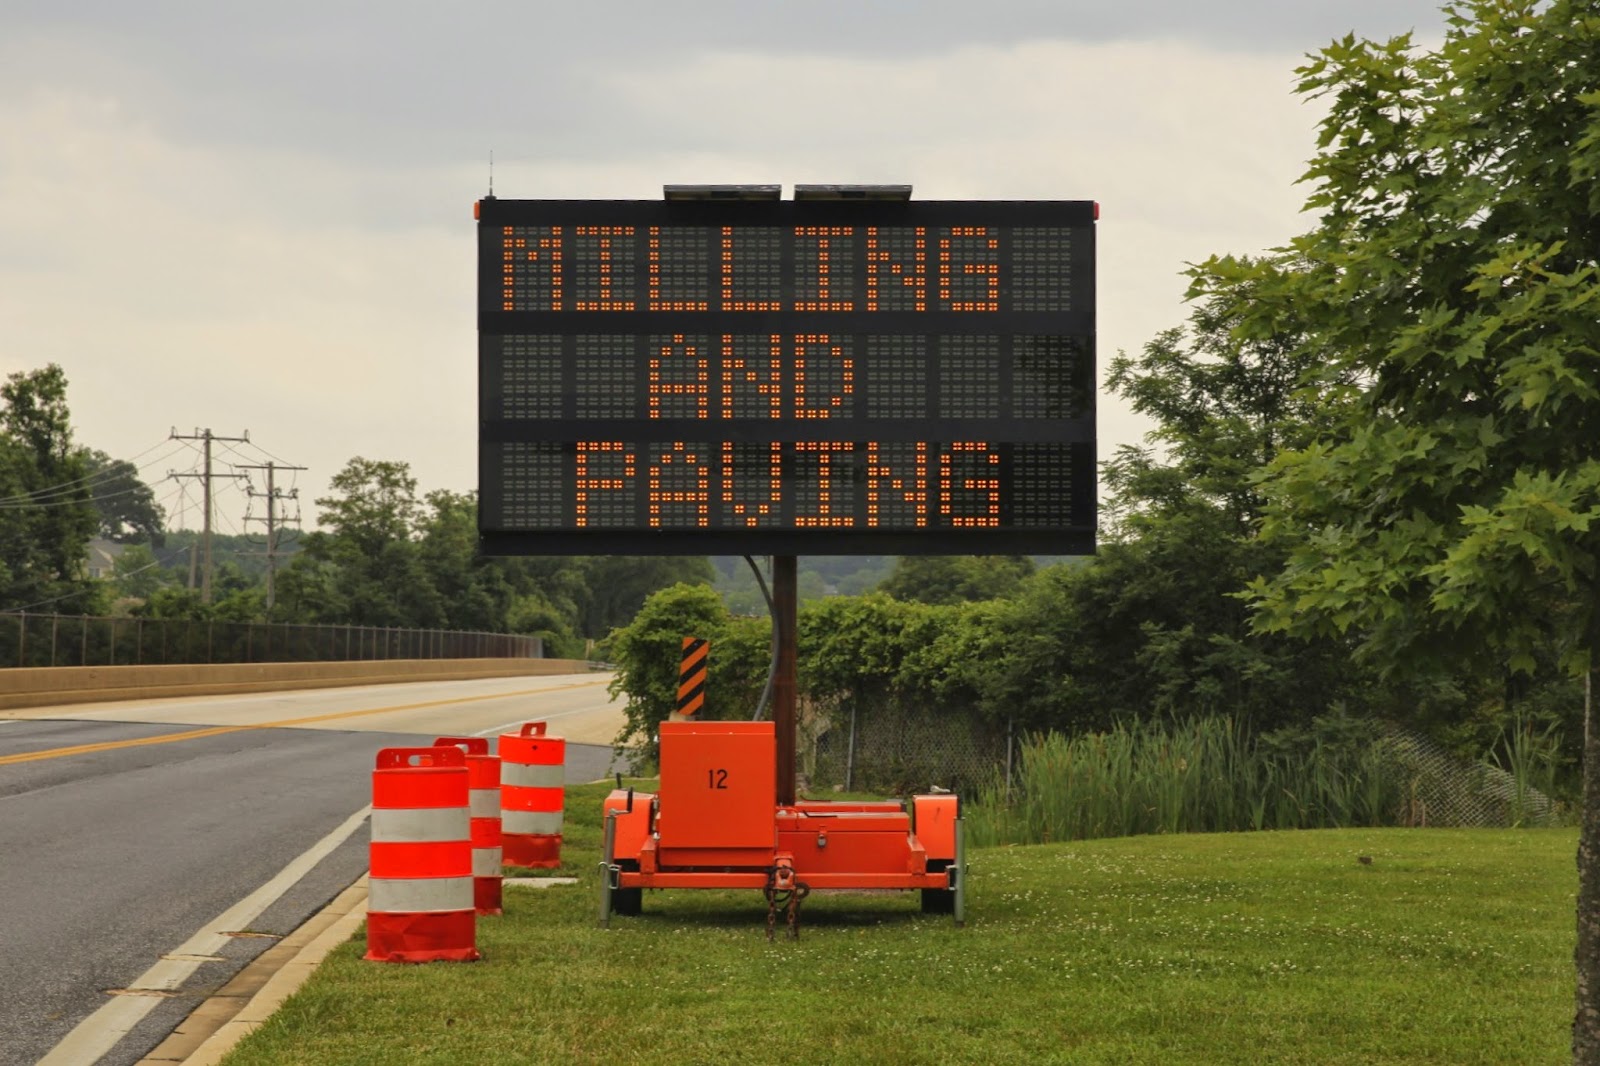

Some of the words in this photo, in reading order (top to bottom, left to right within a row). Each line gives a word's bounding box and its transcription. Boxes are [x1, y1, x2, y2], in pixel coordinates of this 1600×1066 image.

[503, 226, 998, 311] MILLING
[649, 334, 853, 419] AND
[576, 441, 999, 527] PAVING
[708, 769, 728, 789] 12
